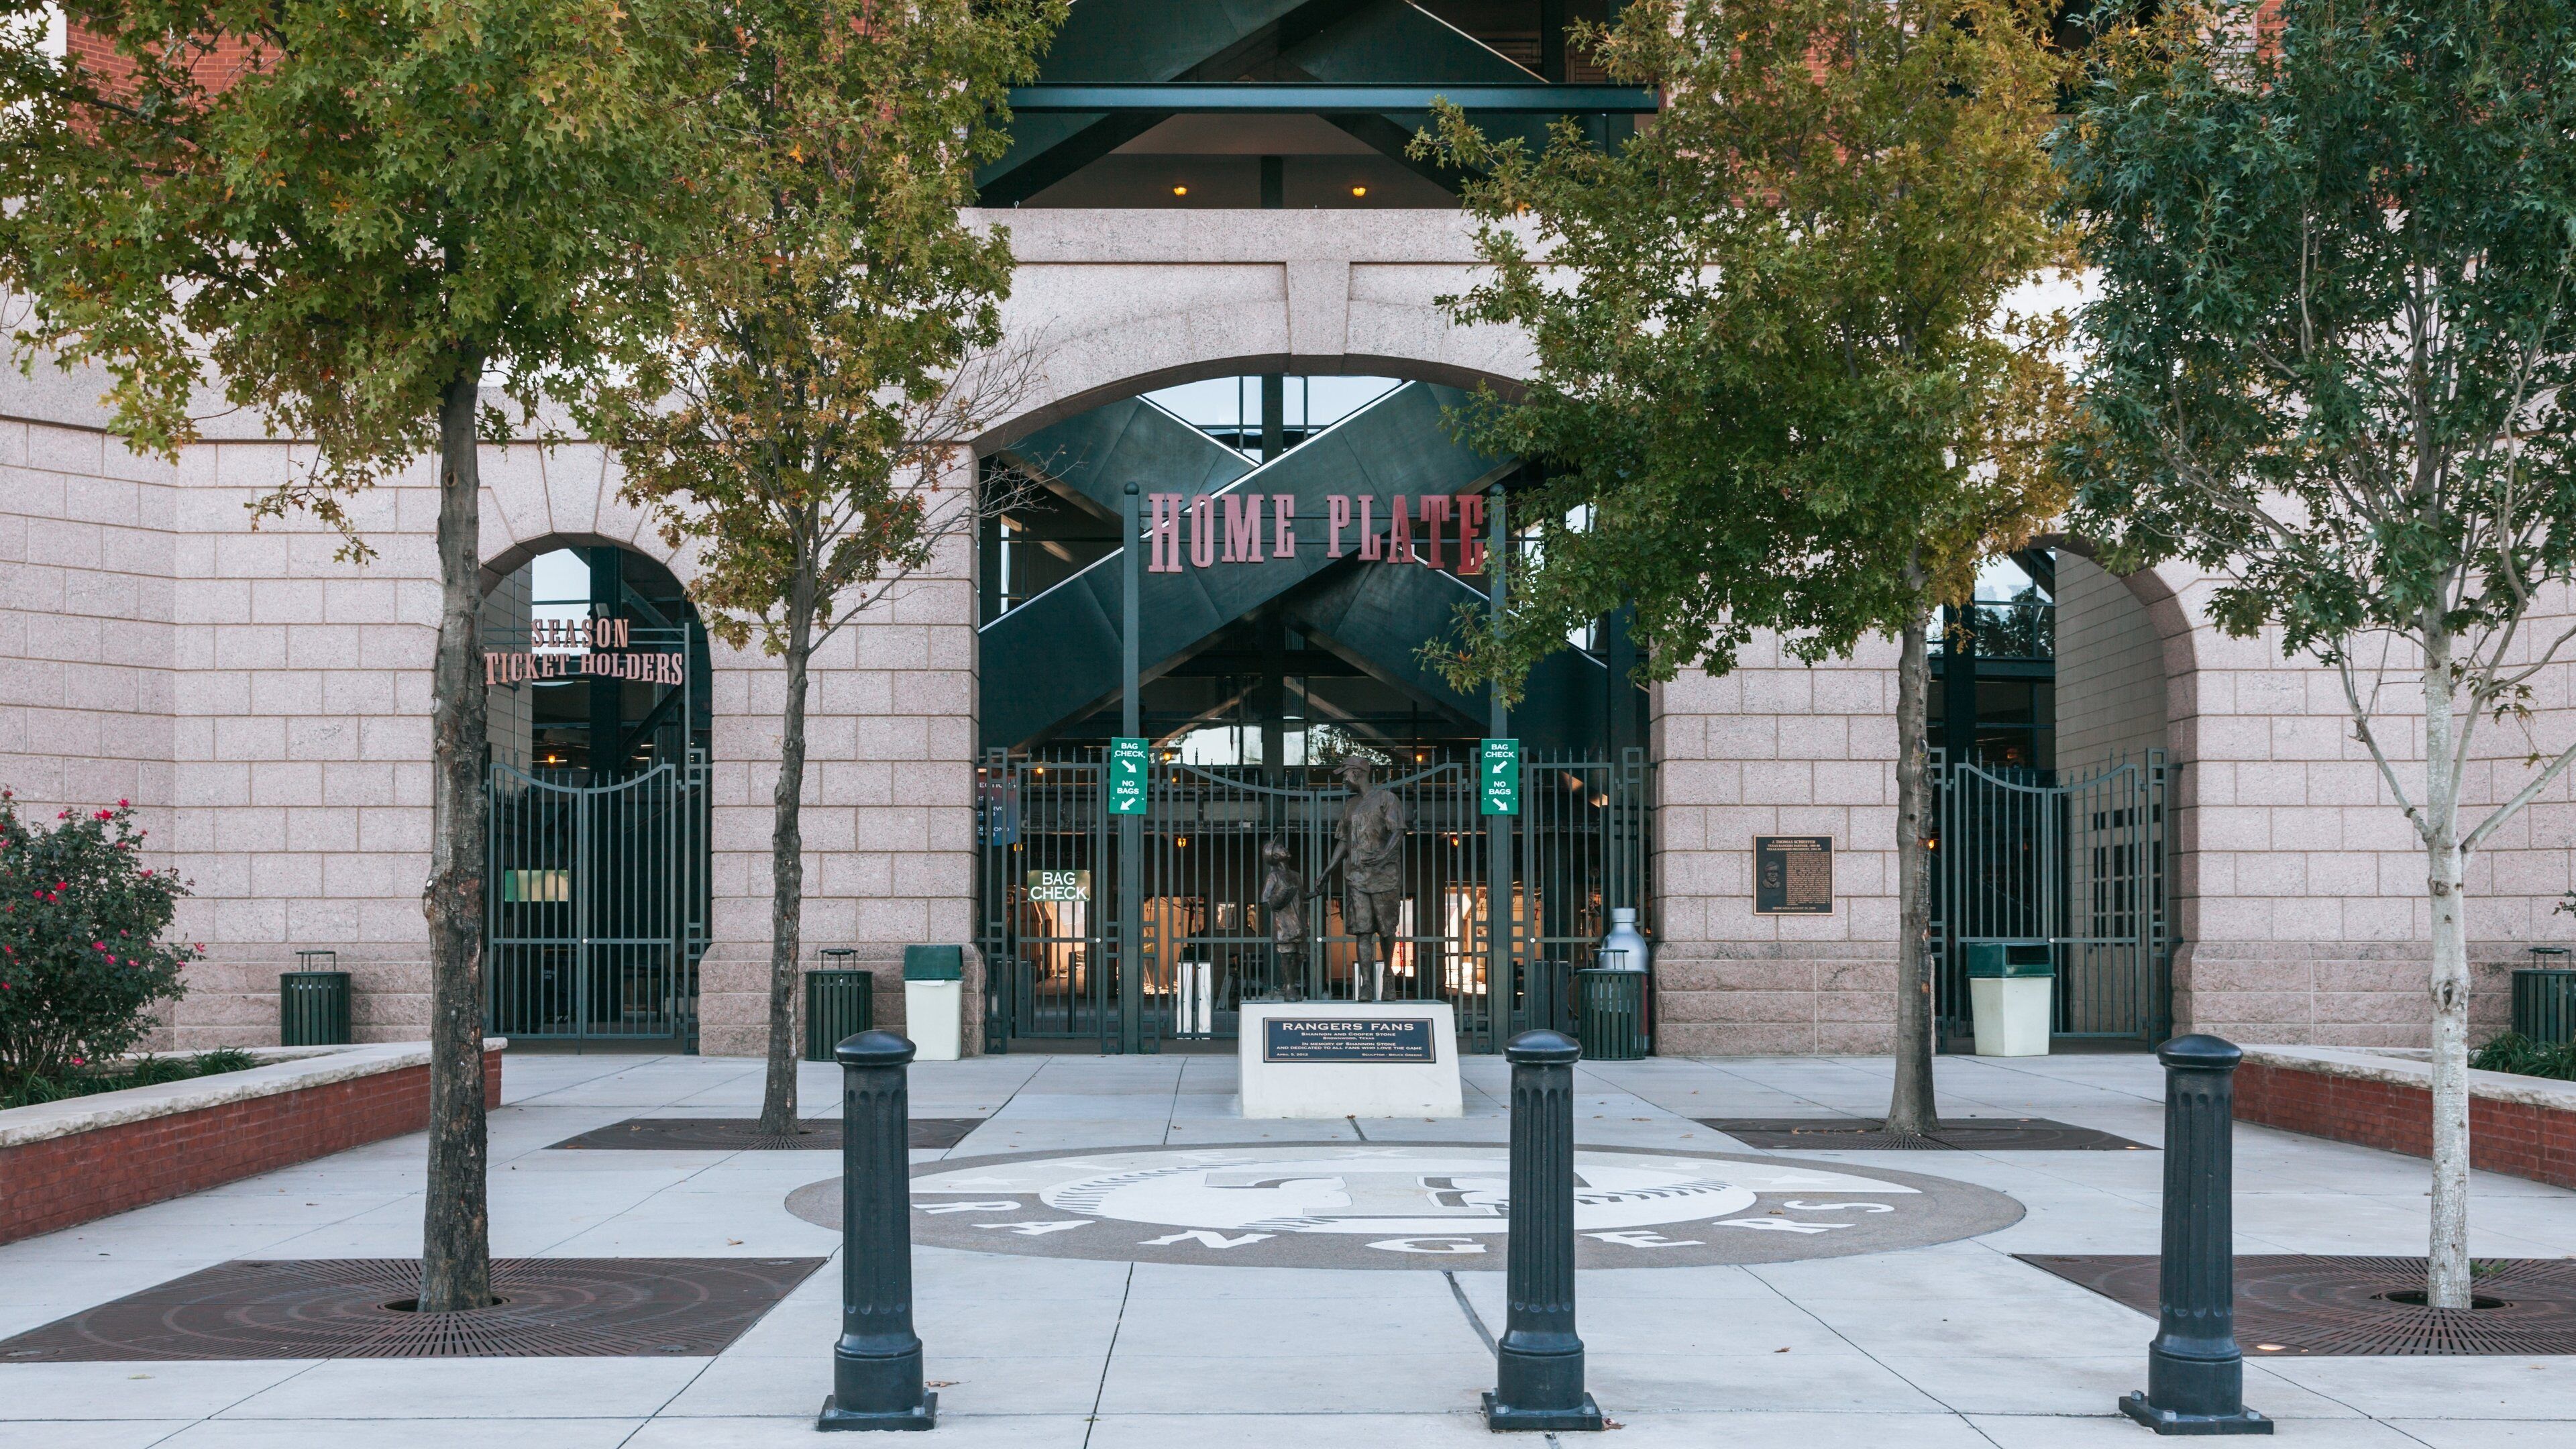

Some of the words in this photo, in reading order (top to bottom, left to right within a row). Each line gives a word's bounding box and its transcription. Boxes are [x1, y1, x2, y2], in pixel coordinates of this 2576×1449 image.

[1148, 492, 1295, 573] HOME
[1326, 494, 1484, 576] PLATE
[531, 618, 629, 648] SEASON
[484, 652, 570, 685] TICKET
[580, 653, 683, 686] HOLDERS
[1030, 886, 1087, 900] CHECK
[1042, 872, 1075, 885] BAG
[1283, 1022, 1363, 1030] RANGERS
[912, 1199, 1895, 1254] RANGERS
